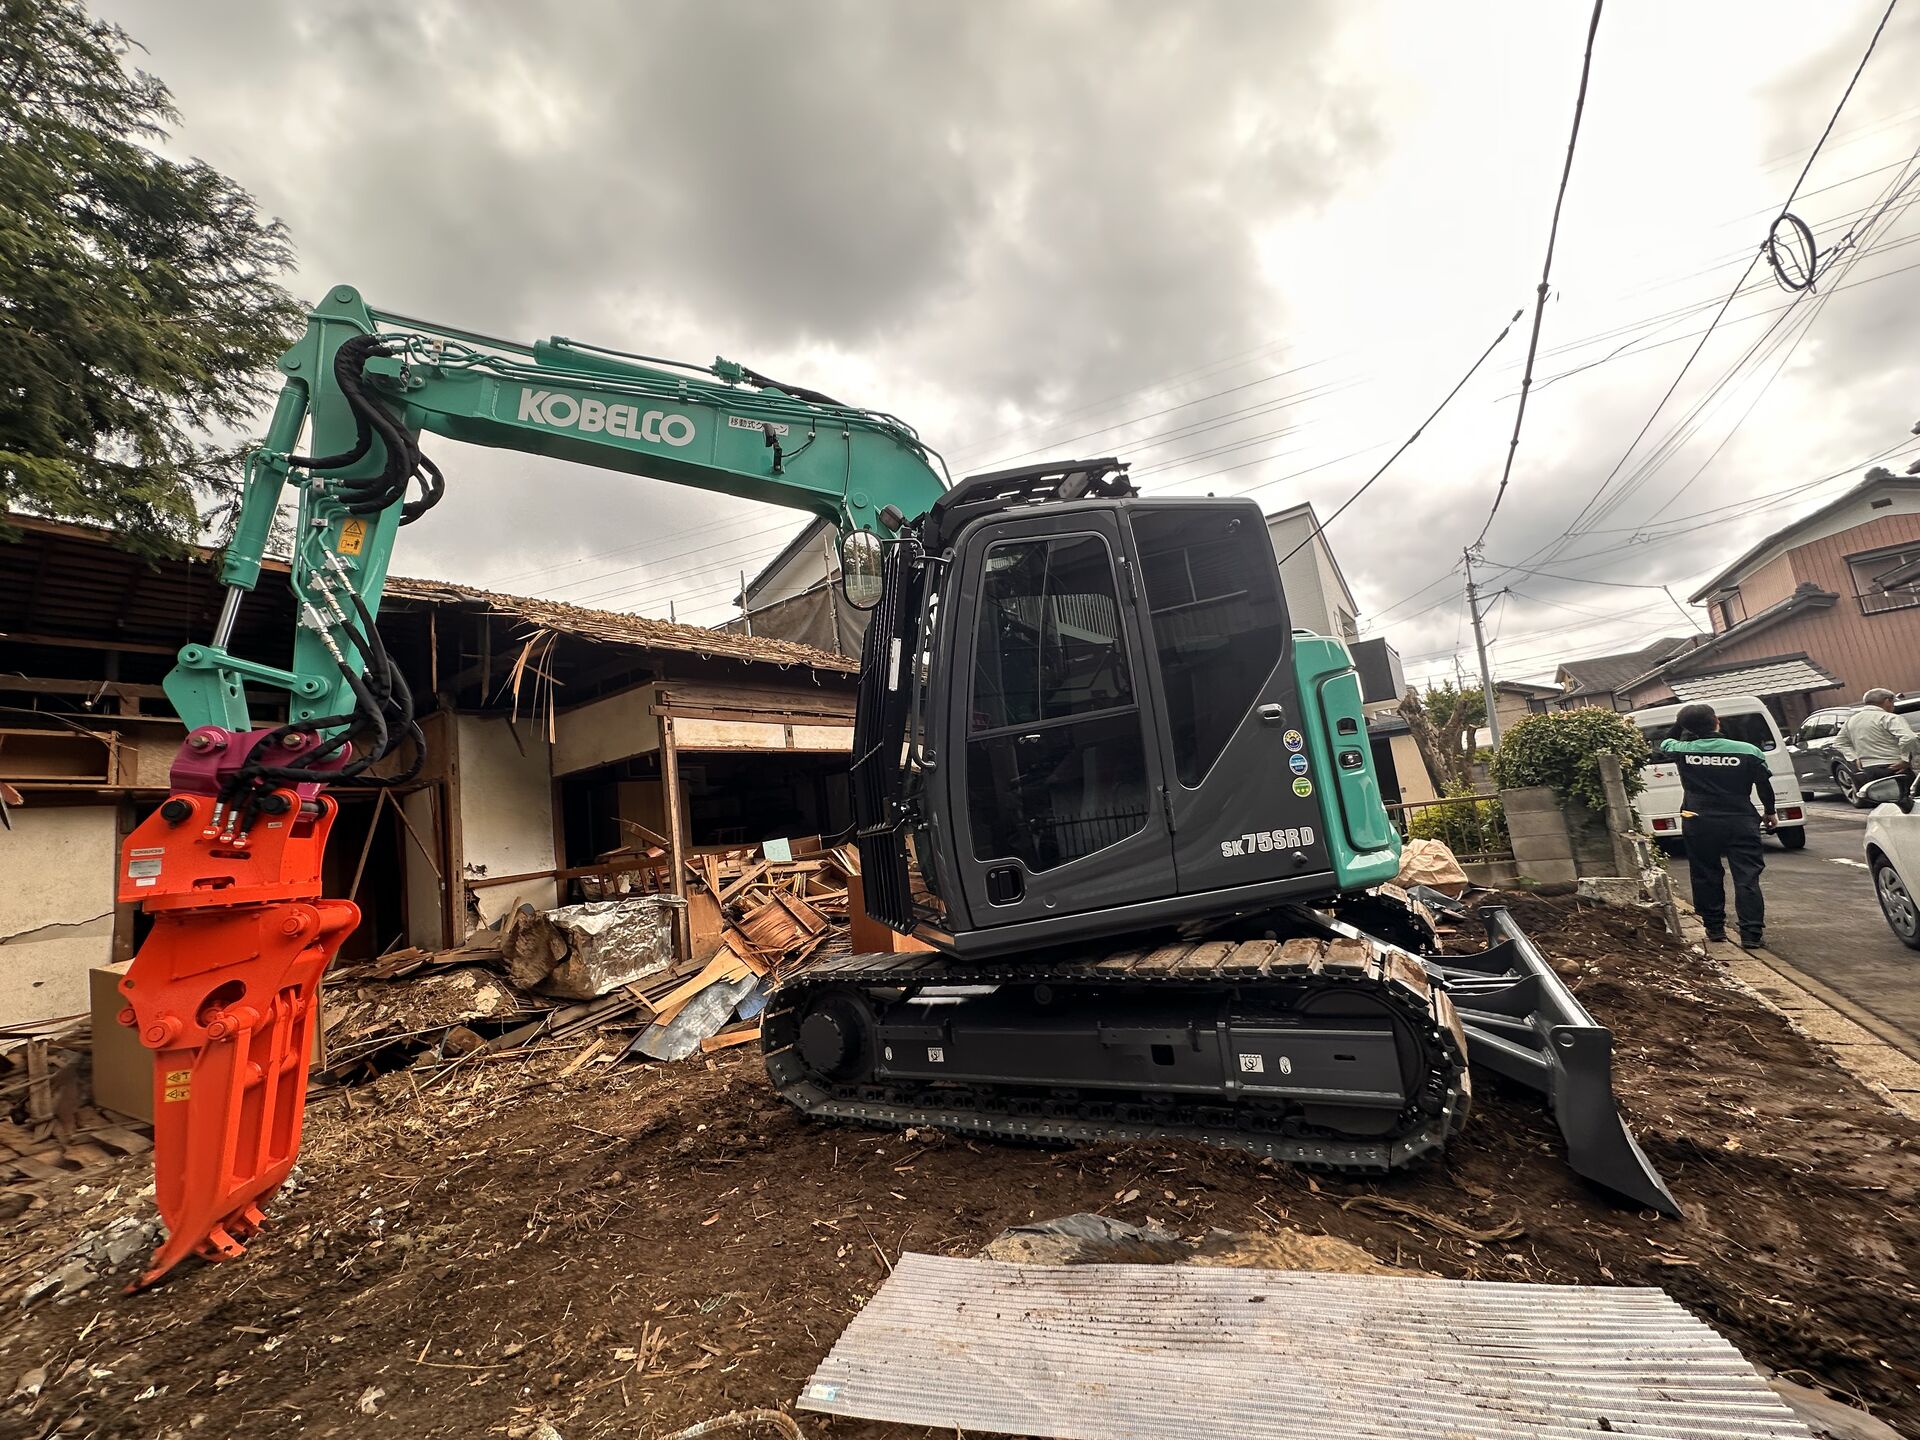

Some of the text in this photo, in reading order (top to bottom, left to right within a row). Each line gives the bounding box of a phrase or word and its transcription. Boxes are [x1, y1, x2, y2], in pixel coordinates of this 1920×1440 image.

[517, 387, 696, 447] KOBELCO
[1685, 754, 1741, 767] KOBELCO
[1220, 826, 1315, 858] SK75SRD
